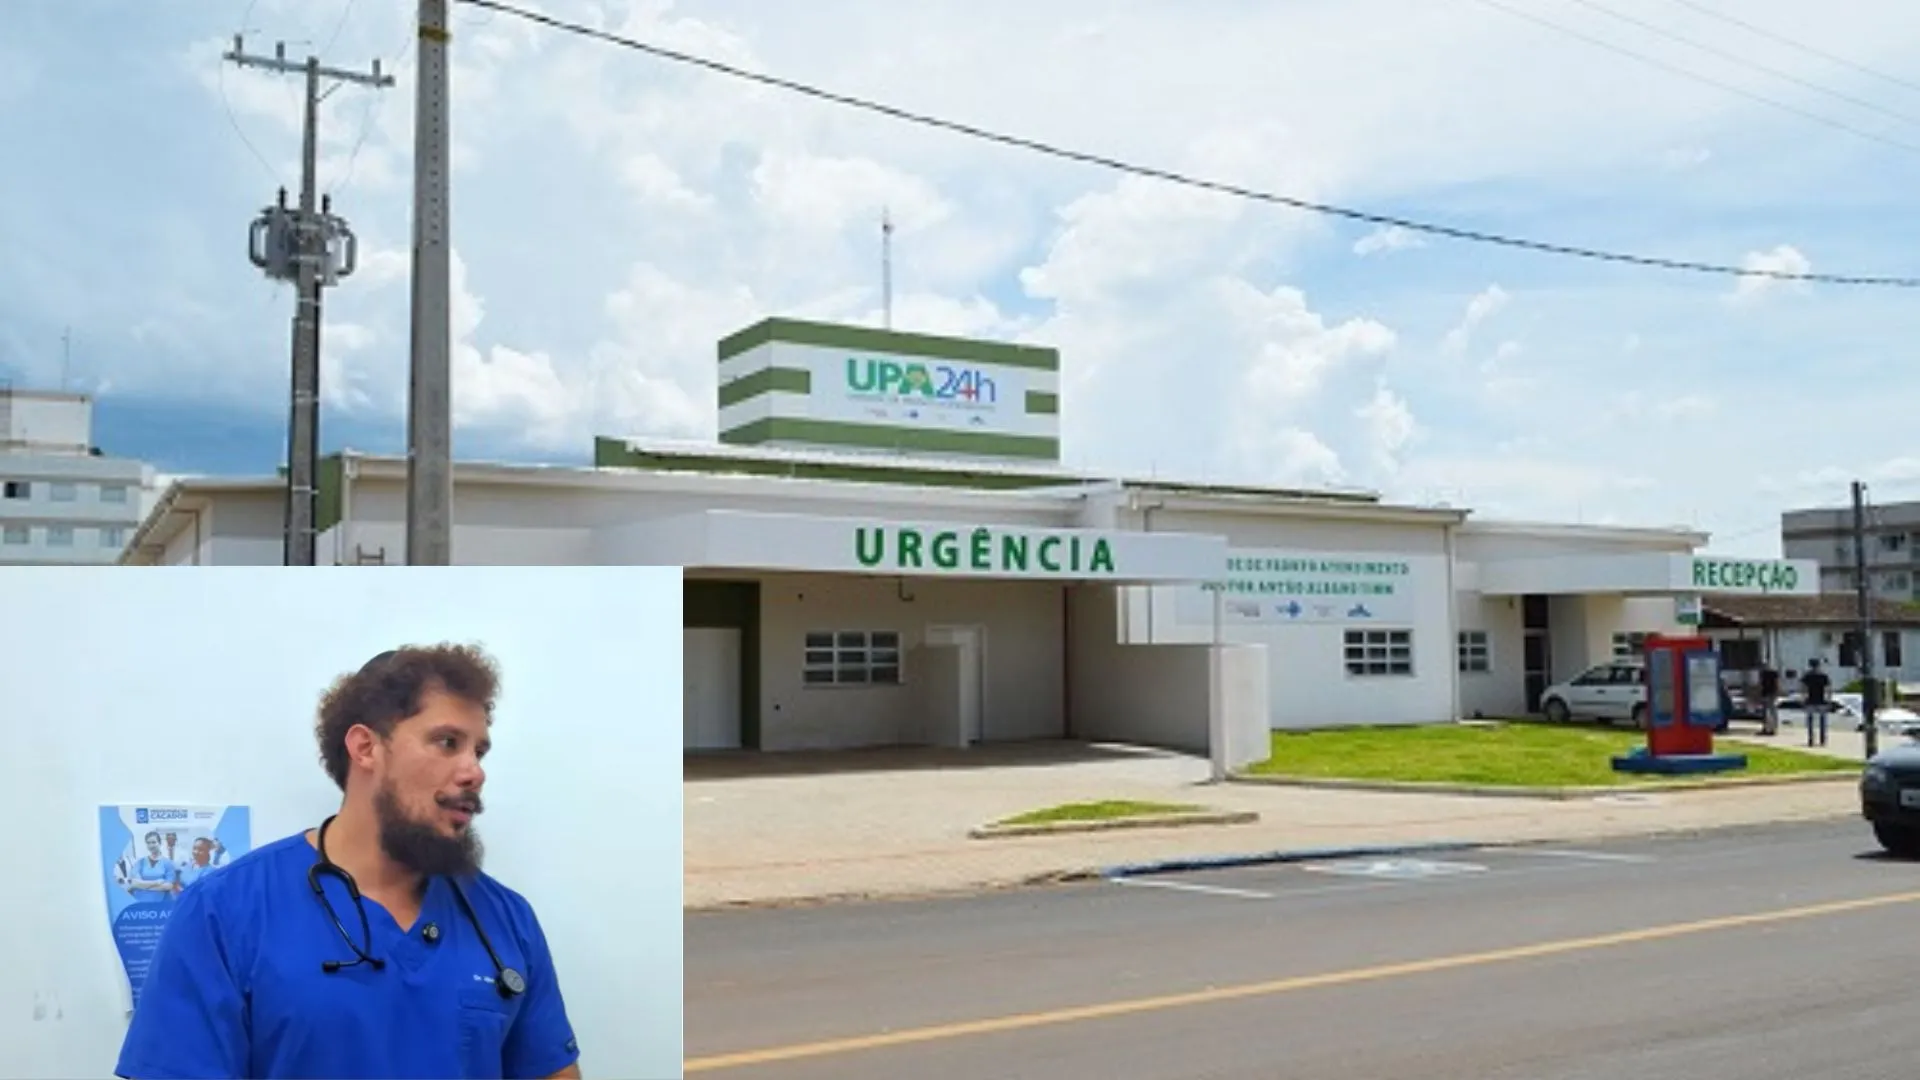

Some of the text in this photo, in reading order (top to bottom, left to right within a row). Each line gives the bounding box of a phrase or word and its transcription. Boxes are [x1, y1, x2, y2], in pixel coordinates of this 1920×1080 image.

[855, 527, 1115, 573] URGÊNCIA
[1692, 559, 1799, 593] RECEPÇÃO
[122, 910, 158, 921] AVISO
